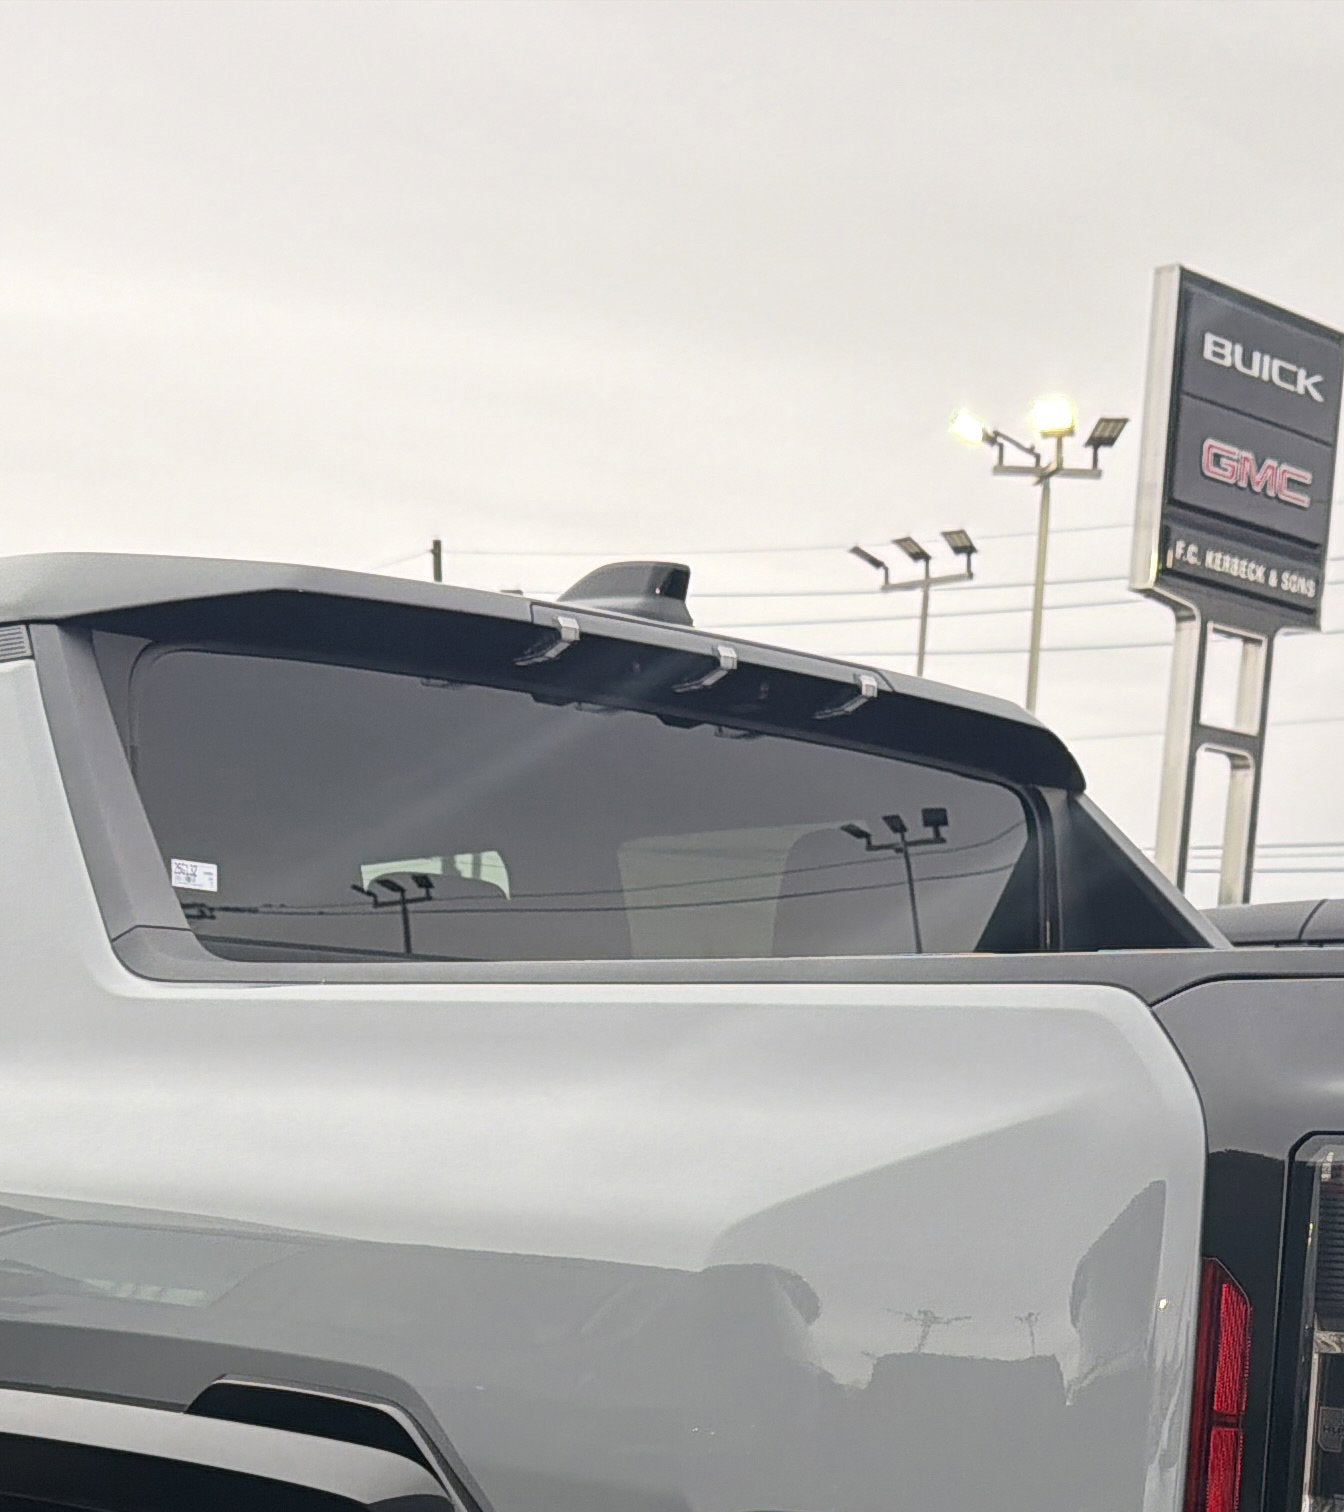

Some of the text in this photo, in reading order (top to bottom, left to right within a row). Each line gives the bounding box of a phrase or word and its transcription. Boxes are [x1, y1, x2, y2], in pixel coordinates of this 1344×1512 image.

[1203, 332, 1324, 402] BUICK
[1201, 437, 1313, 508] GMC
[1206, 550, 1267, 584] KERBECK
[1268, 569, 1278, 587] &
[1281, 571, 1316, 598] SONS
